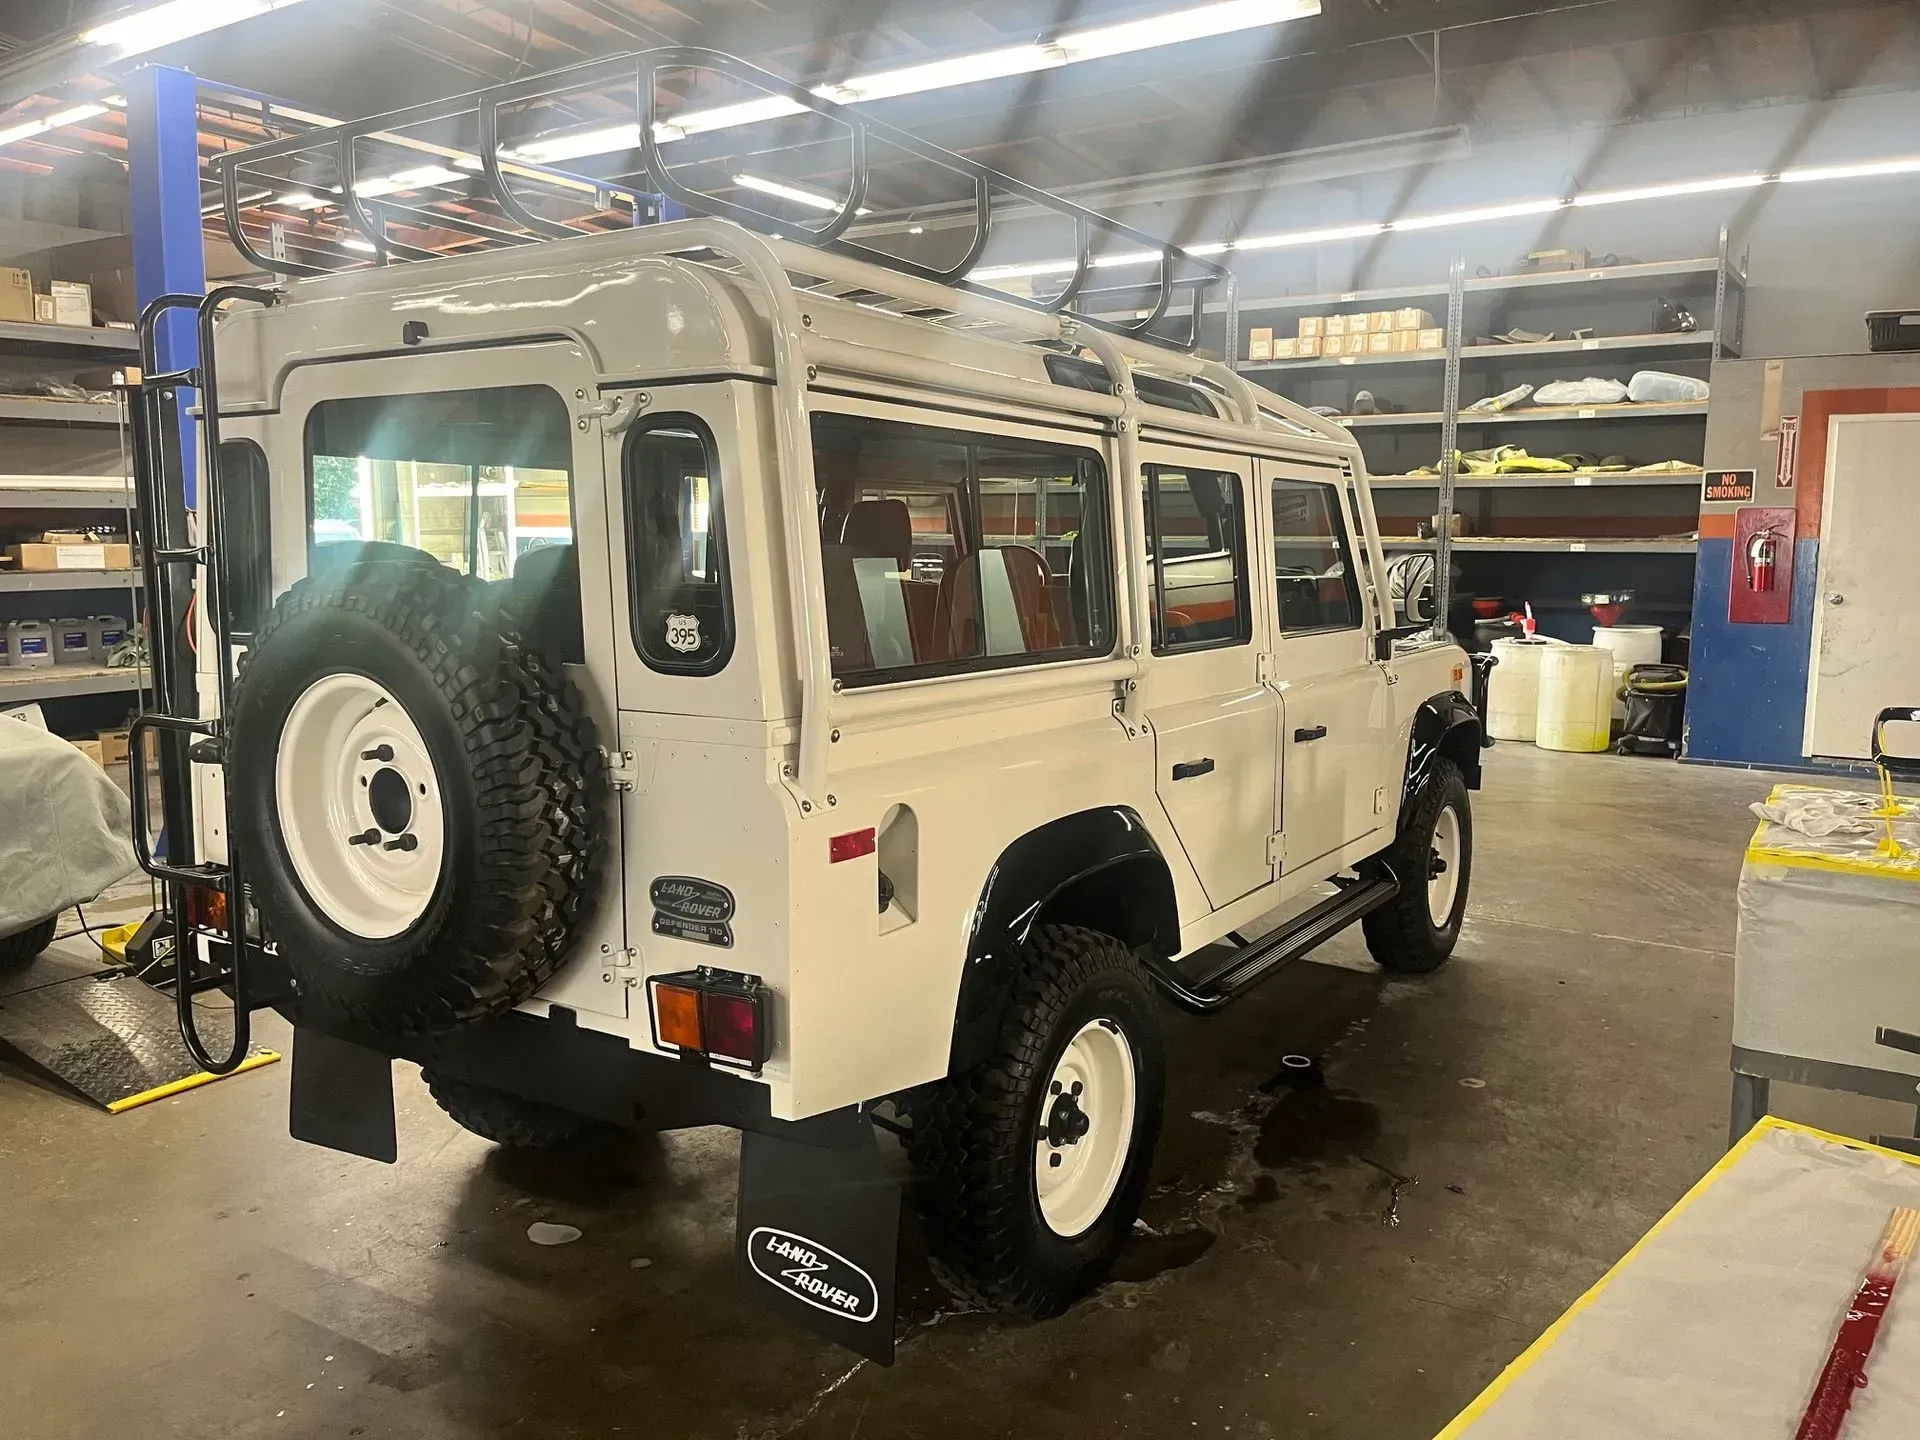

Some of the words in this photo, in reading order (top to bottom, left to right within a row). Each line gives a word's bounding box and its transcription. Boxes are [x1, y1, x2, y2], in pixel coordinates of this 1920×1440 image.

[1782, 422, 1796, 431] FIRE
[1722, 473, 1737, 486] NO
[1706, 485, 1751, 498] SMOKING
[671, 628, 696, 645] 395
[661, 882, 694, 897] LAND
[680, 902, 721, 918] ROVER
[659, 917, 707, 933] DEFENDER
[708, 926, 723, 936] 110
[765, 1235, 818, 1267] LAND
[795, 1272, 860, 1312] ROVER
